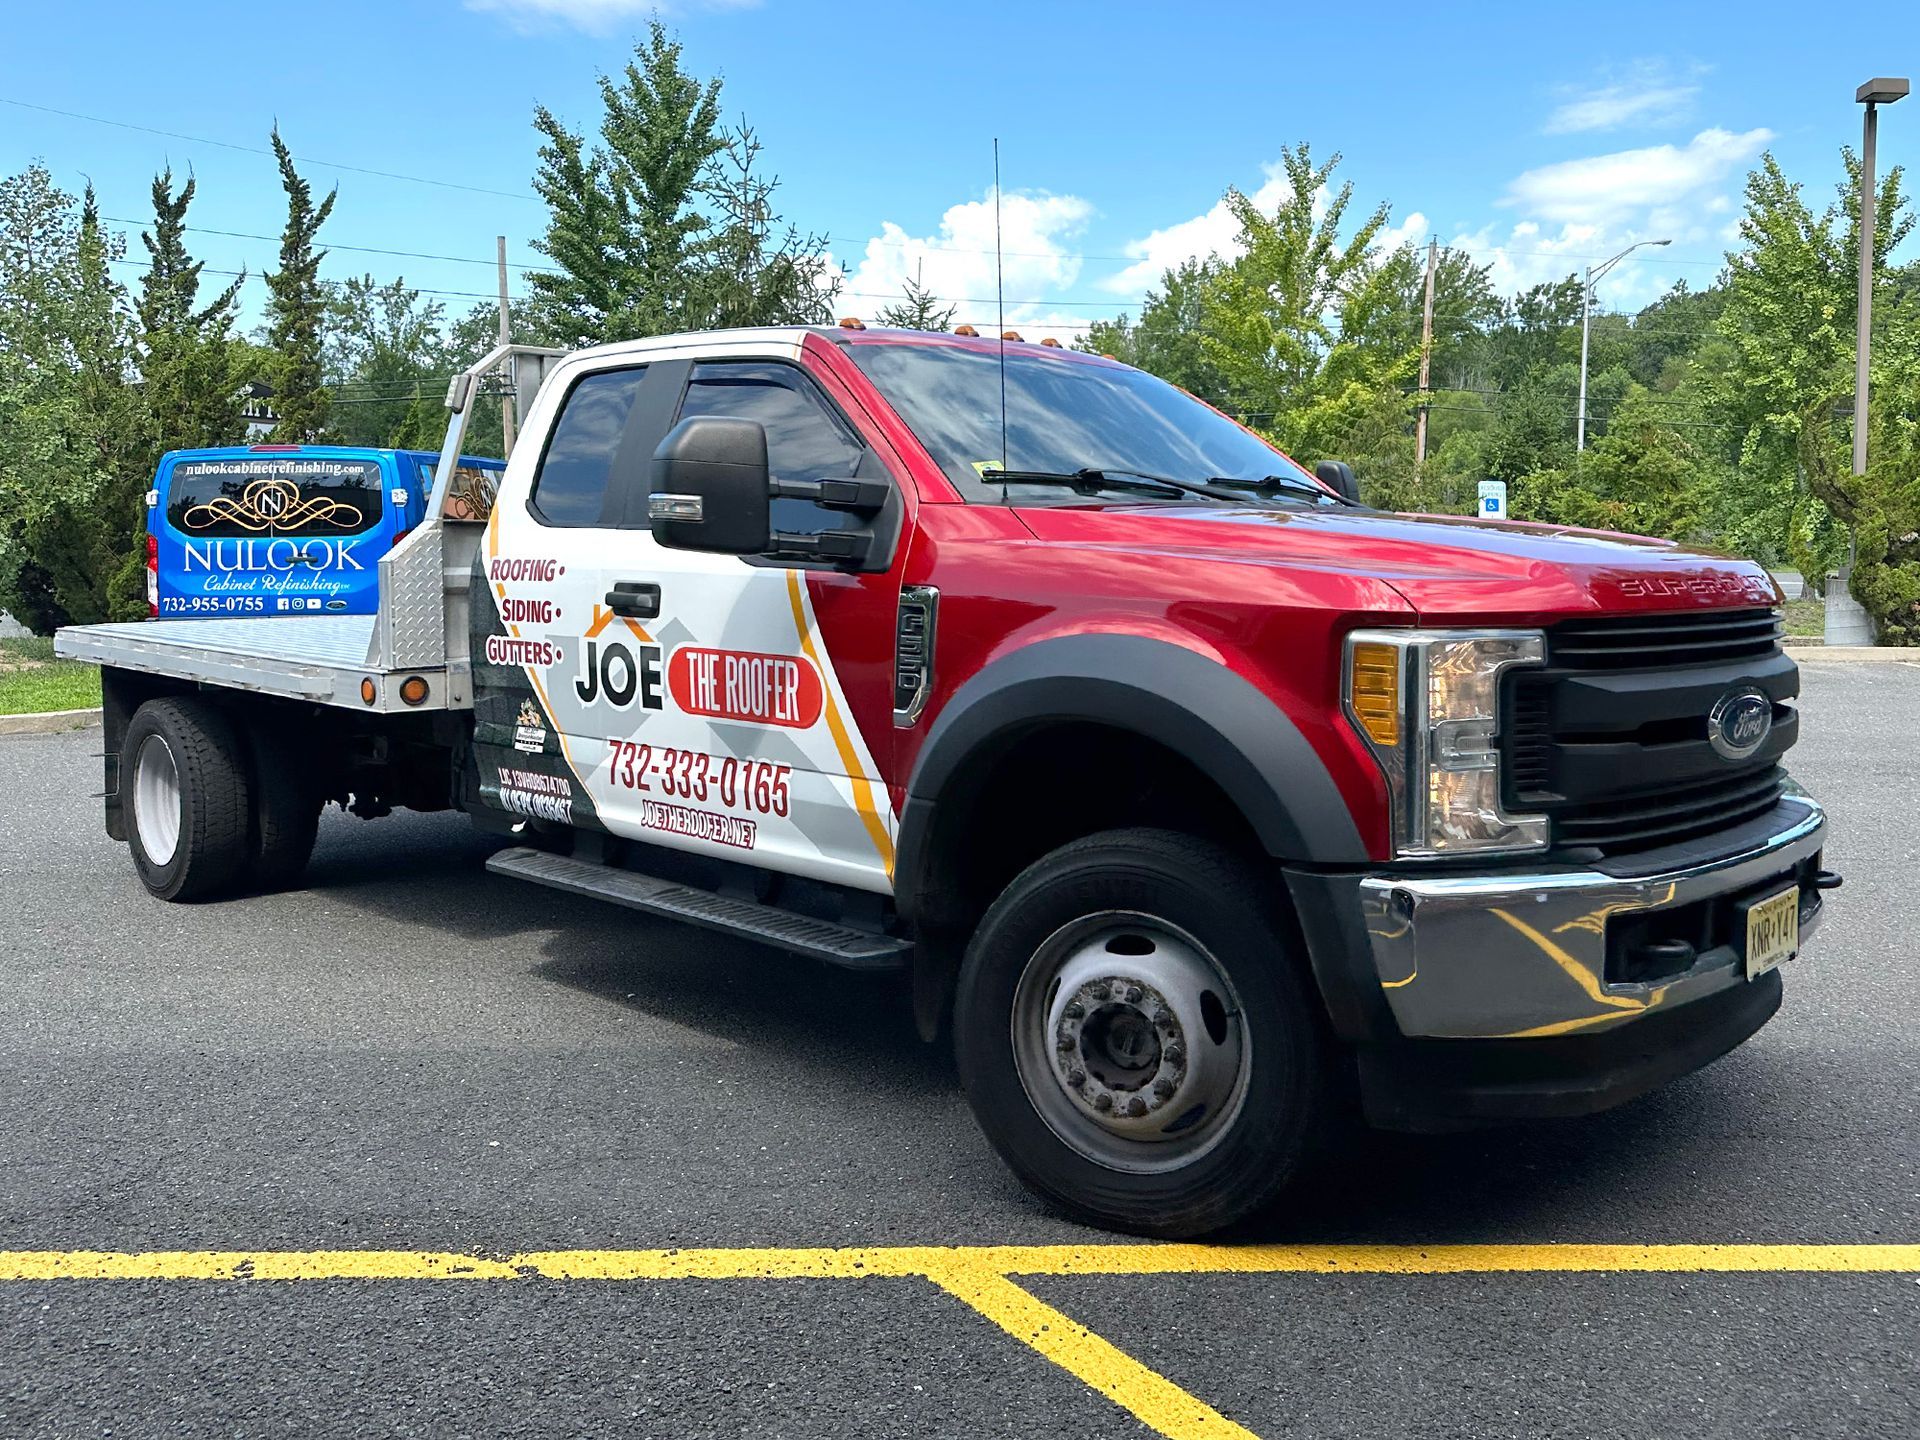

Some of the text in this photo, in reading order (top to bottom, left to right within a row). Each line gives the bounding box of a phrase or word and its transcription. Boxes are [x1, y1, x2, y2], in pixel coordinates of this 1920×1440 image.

[186, 462, 364, 476] nulookcabinetrefinishing.com
[261, 491, 281, 514] N
[184, 540, 364, 571] NULOOK
[203, 571, 341, 596] Cabinet Refinishing
[490, 559, 556, 582] ROOFING
[163, 597, 264, 611] 732-955-0755
[502, 598, 552, 624] SIDING
[488, 638, 553, 665] GUTTERS
[575, 641, 664, 711] JOE
[685, 652, 800, 722] THE ROOFER
[498, 767, 512, 786] LIC
[609, 739, 792, 818] 732-333-0165
[1751, 916, 1771, 961] XNR
